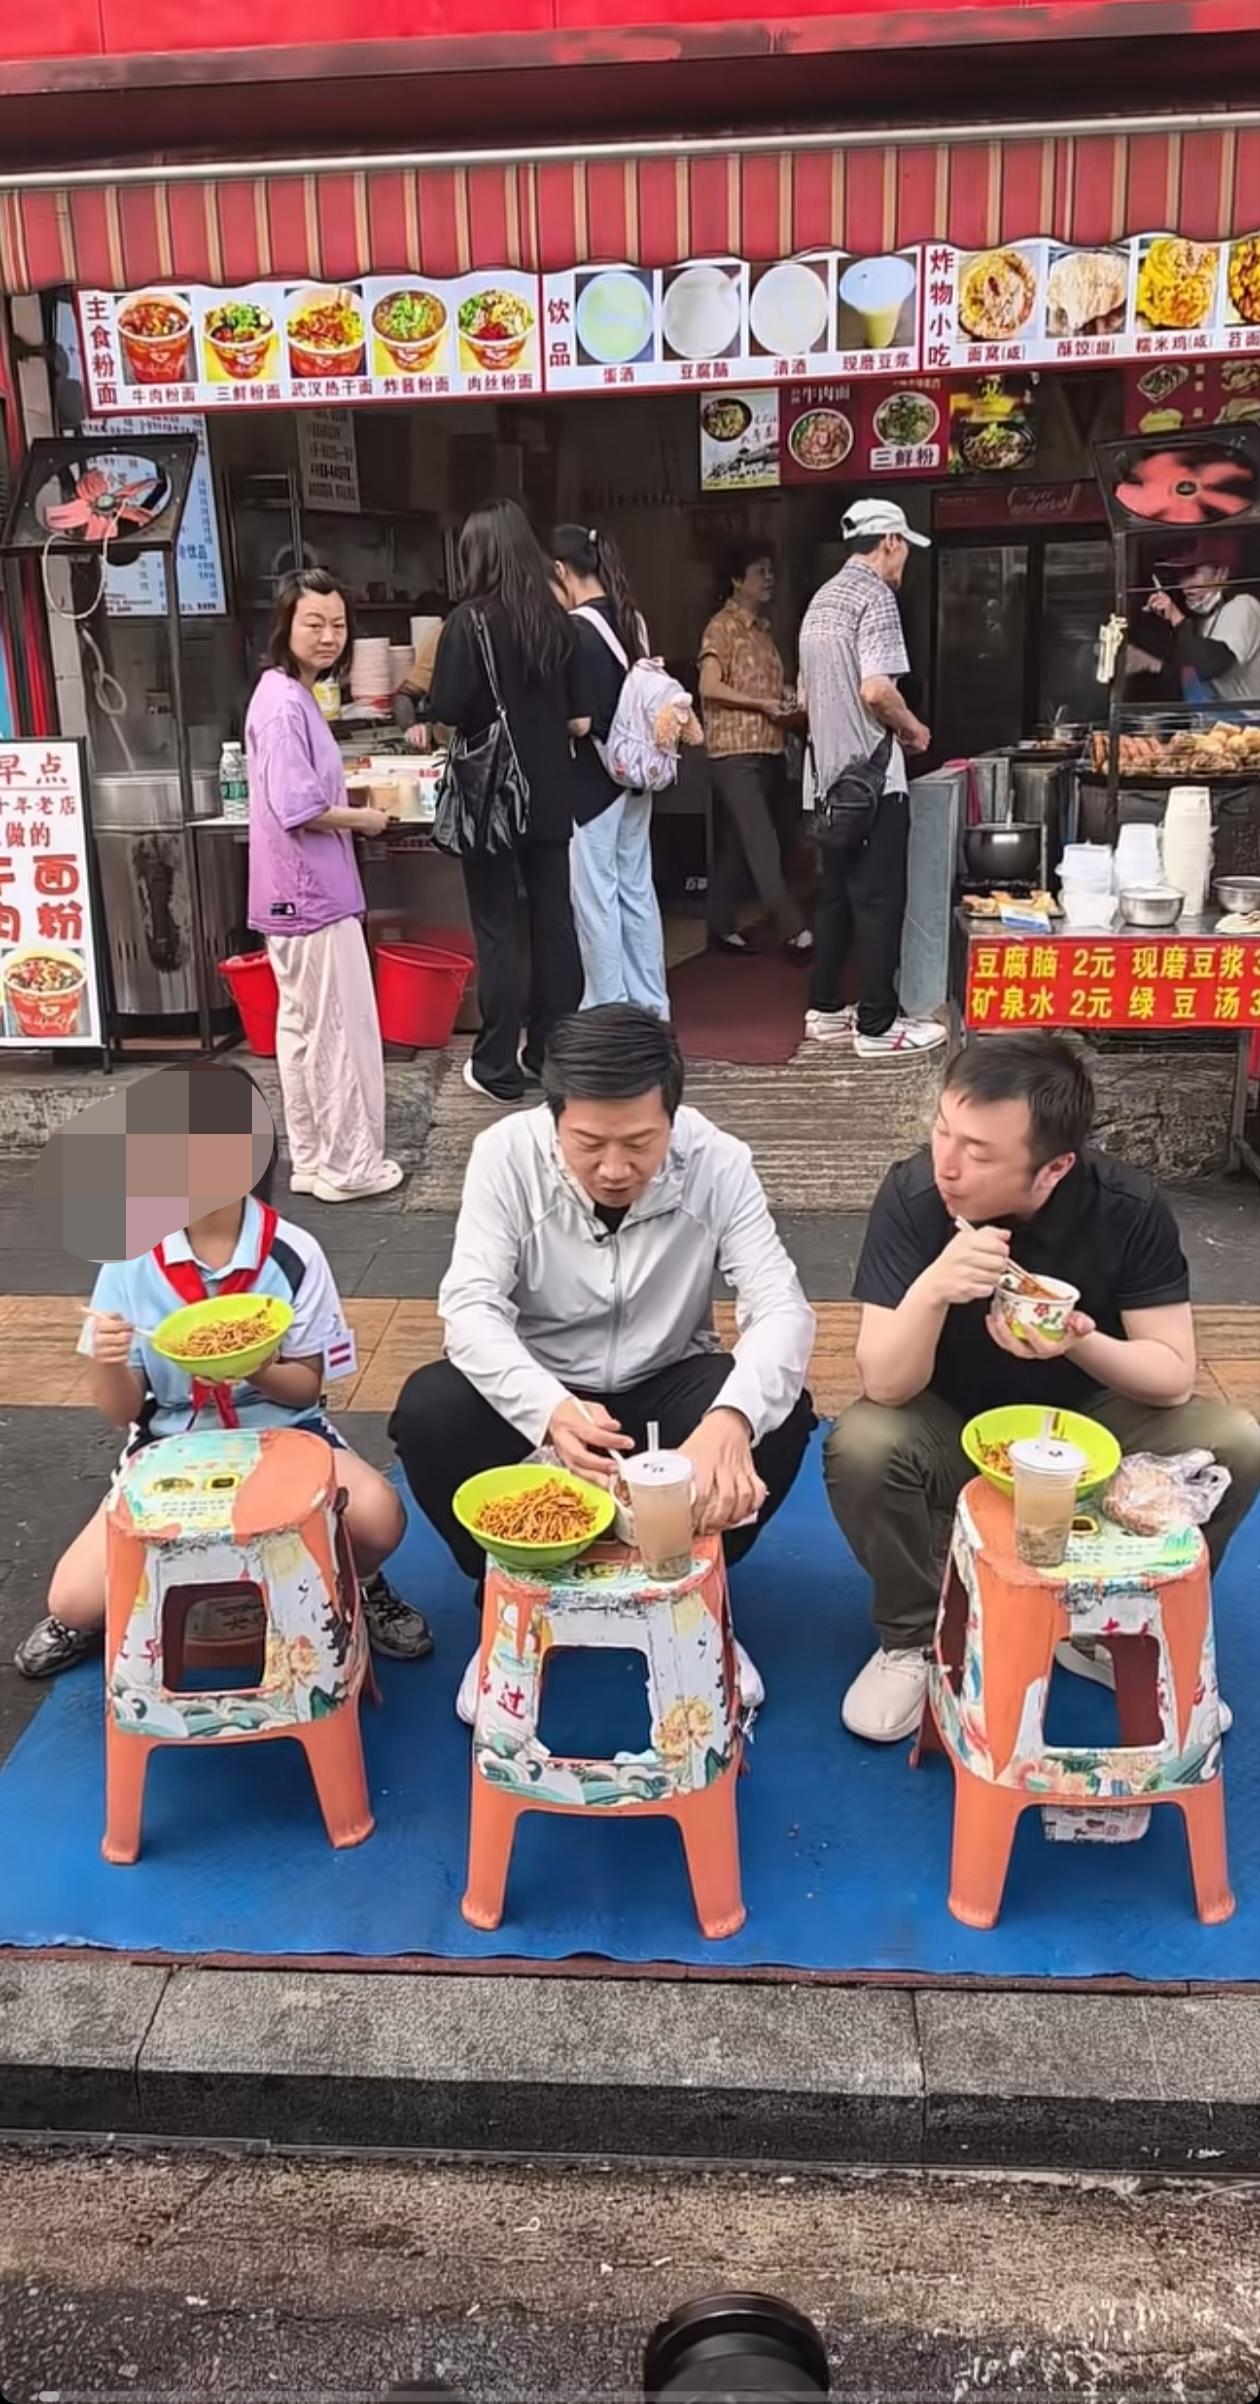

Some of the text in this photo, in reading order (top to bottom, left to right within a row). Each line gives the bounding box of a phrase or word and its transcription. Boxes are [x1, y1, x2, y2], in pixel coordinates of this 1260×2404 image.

[927, 249, 954, 367] 炸物小吃
[548, 298, 571, 367] 饮品
[86, 296, 118, 405] 主食粉面
[681, 361, 728, 380] 豆腐脑
[842, 352, 909, 371] 现磨豆浆
[216, 383, 281, 402] 三鲜粉面
[291, 379, 373, 398] 武汉热干面
[384, 376, 449, 394] 炸酱粉面
[468, 374, 533, 392] 肉丝粉面
[132, 386, 196, 404] 牛肉粉面
[873, 449, 936, 469] 三鲜粉
[0, 752, 68, 785] 早点
[0, 821, 51, 848] 做的
[974, 945, 1058, 979] 豆腐脑
[1072, 947, 1116, 978] 2元
[1131, 945, 1246, 979] 现磨豆浆
[971, 986, 1055, 1020] 矿泉水
[1069, 987, 1113, 1019] 2元
